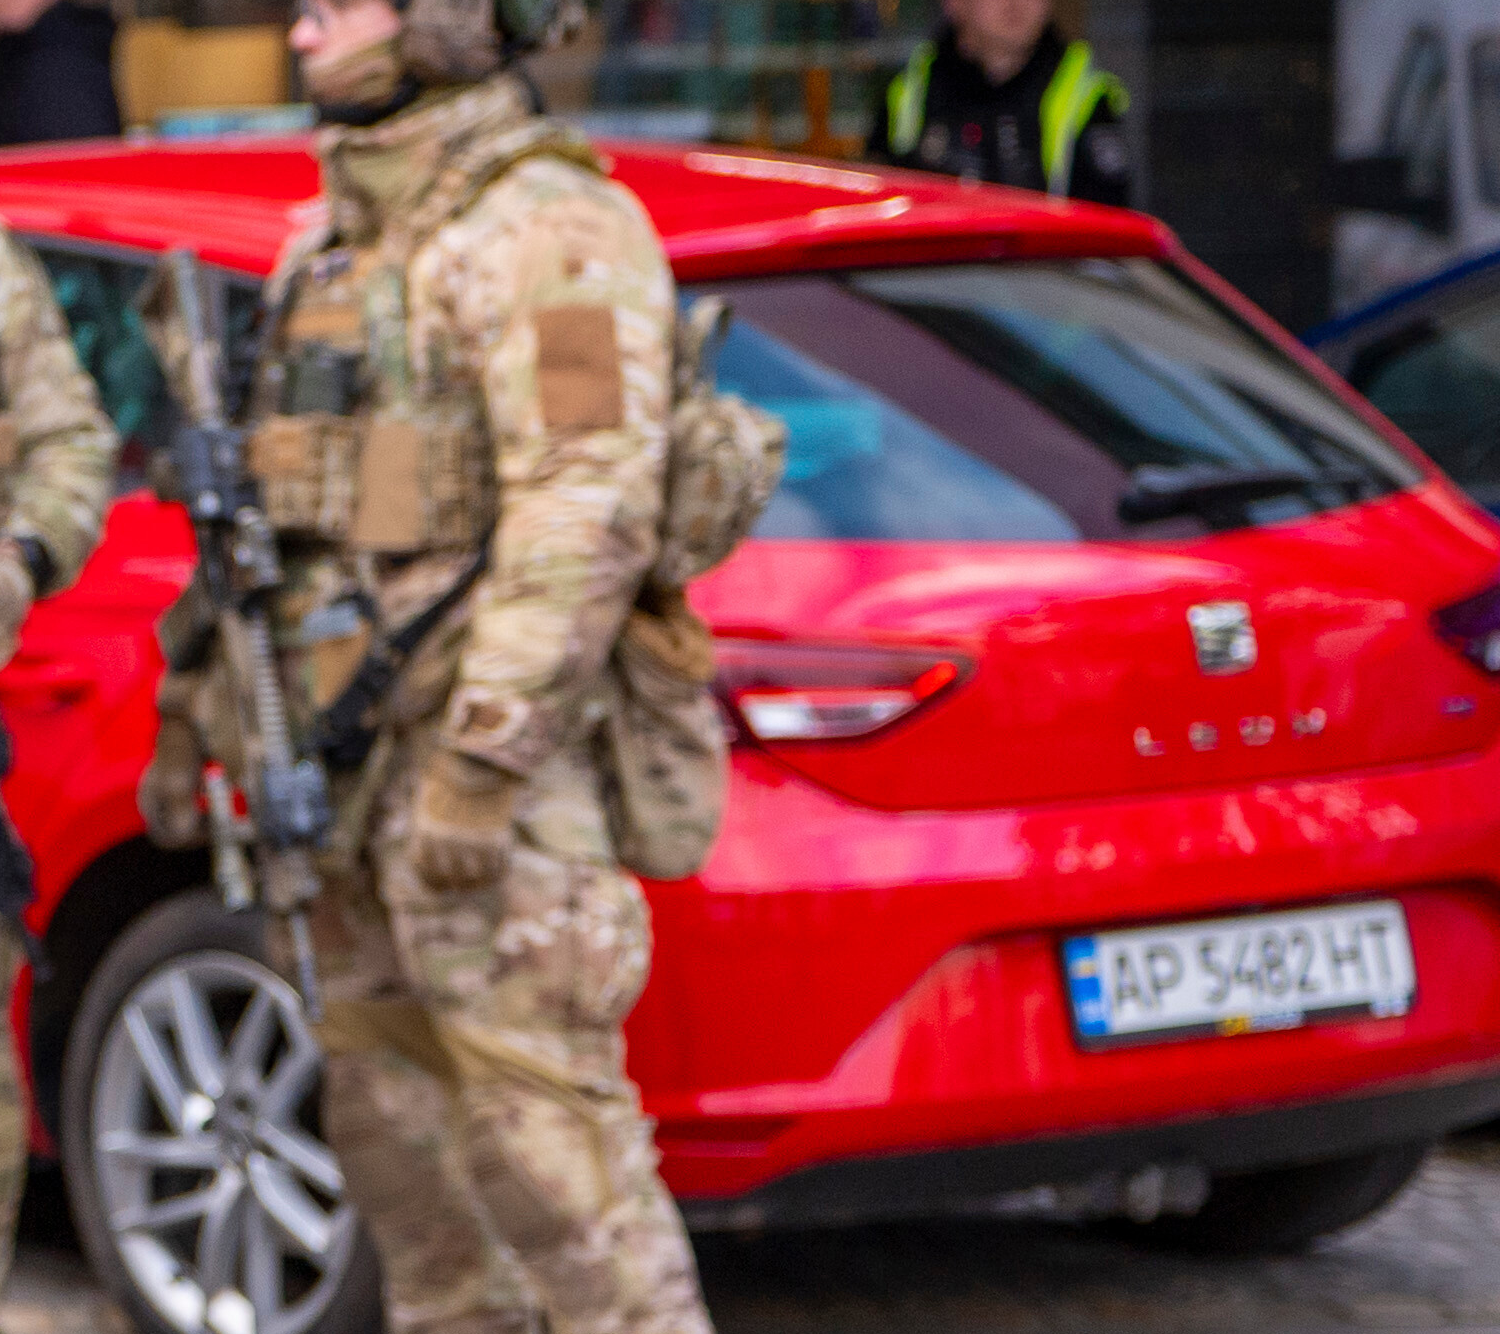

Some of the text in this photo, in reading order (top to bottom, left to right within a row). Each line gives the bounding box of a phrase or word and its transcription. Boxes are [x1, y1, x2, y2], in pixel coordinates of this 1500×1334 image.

[1110, 921, 1390, 1013] AP 5482 HT
